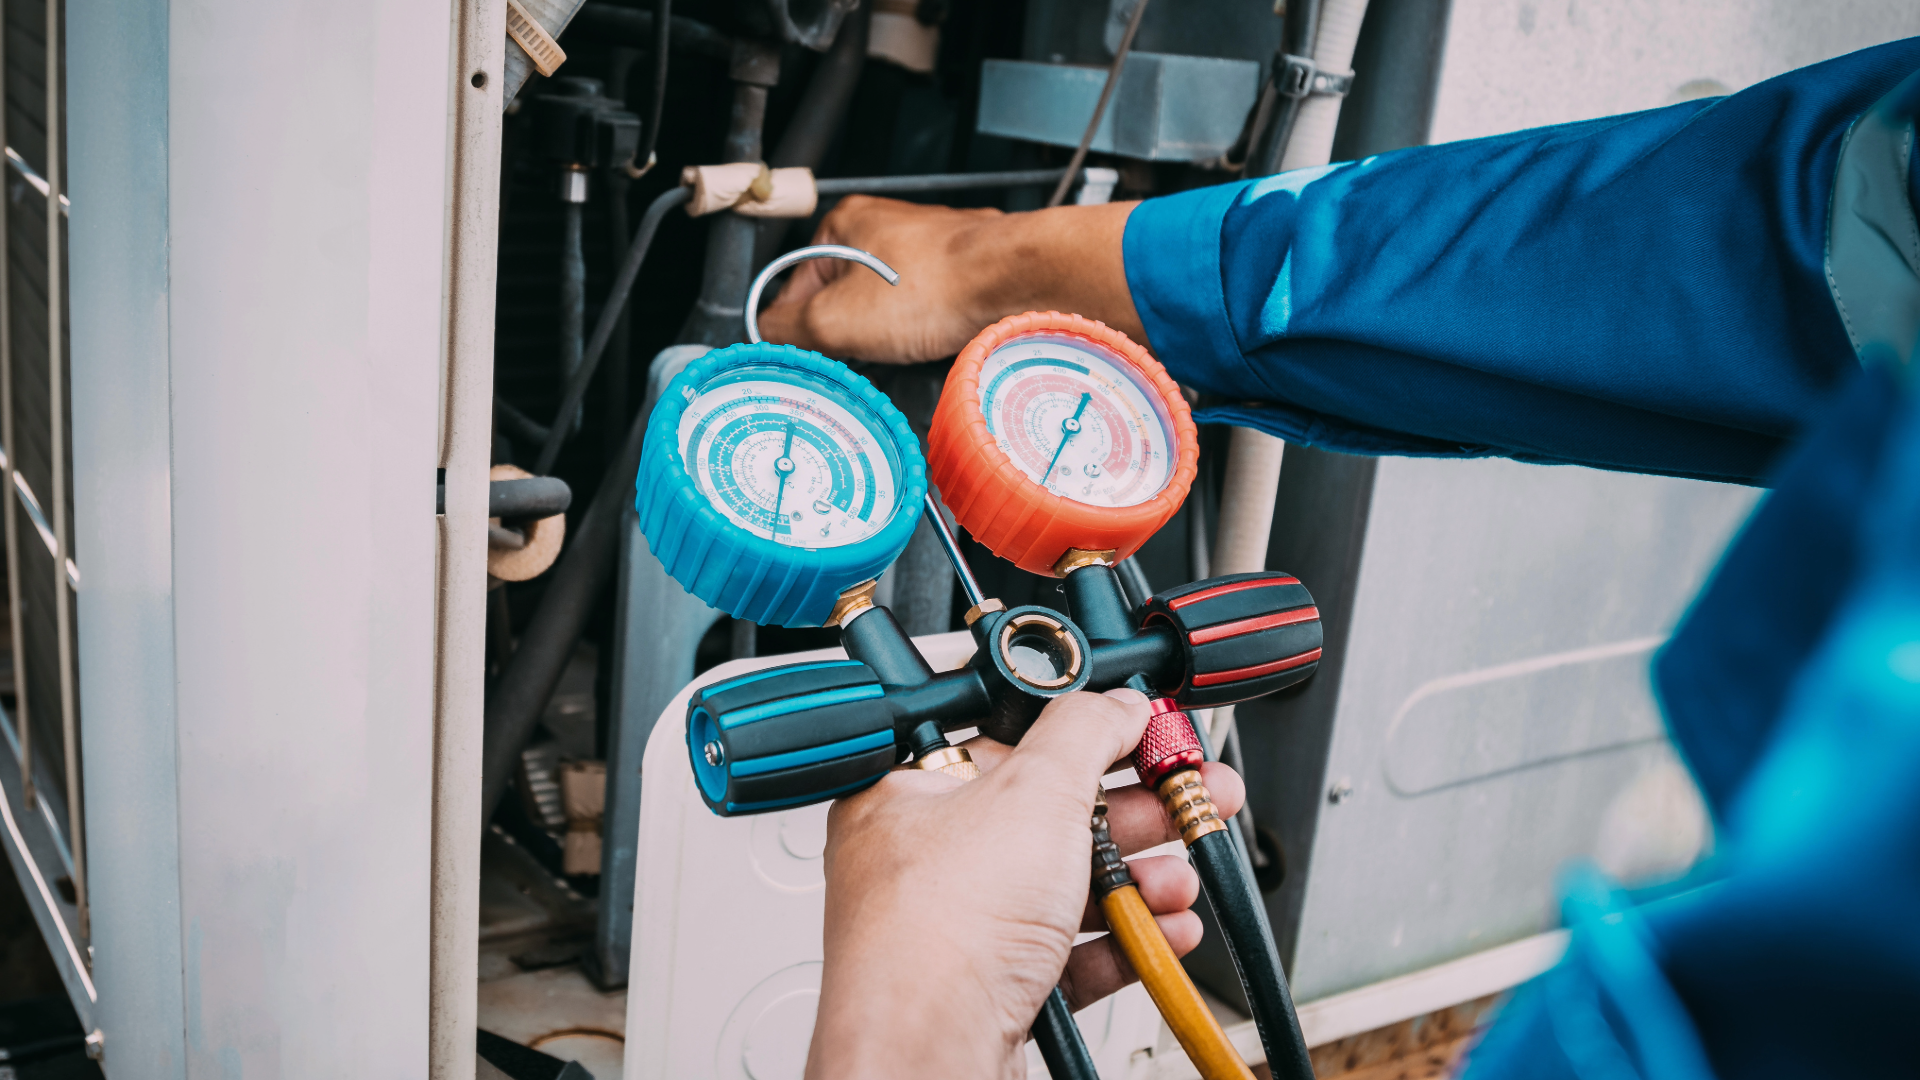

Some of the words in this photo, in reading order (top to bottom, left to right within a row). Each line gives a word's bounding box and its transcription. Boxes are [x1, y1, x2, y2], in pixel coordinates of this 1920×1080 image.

[1012, 371, 1024, 380] 300
[1113, 378, 1123, 387] 35
[1097, 384, 1110, 396] 500
[806, 397, 817, 405] 25
[994, 398, 1002, 411] 200
[691, 411, 701, 420] 15
[722, 411, 738, 422] 250
[789, 408, 804, 418] 350
[1142, 413, 1150, 422] 40
[822, 424, 836, 436] 400
[1128, 420, 1137, 433] 600
[703, 430, 715, 443] 200
[858, 436, 869, 446] 30
[1000, 440, 1011, 452] 100
[847, 450, 857, 463] 450
[1154, 451, 1160, 460] 45
[698, 458, 706, 470] 150
[1130, 460, 1140, 472] 700
[706, 488, 718, 502] 100
[878, 490, 886, 500] 35
[1102, 486, 1116, 495] 800
[848, 506, 859, 520] 550
